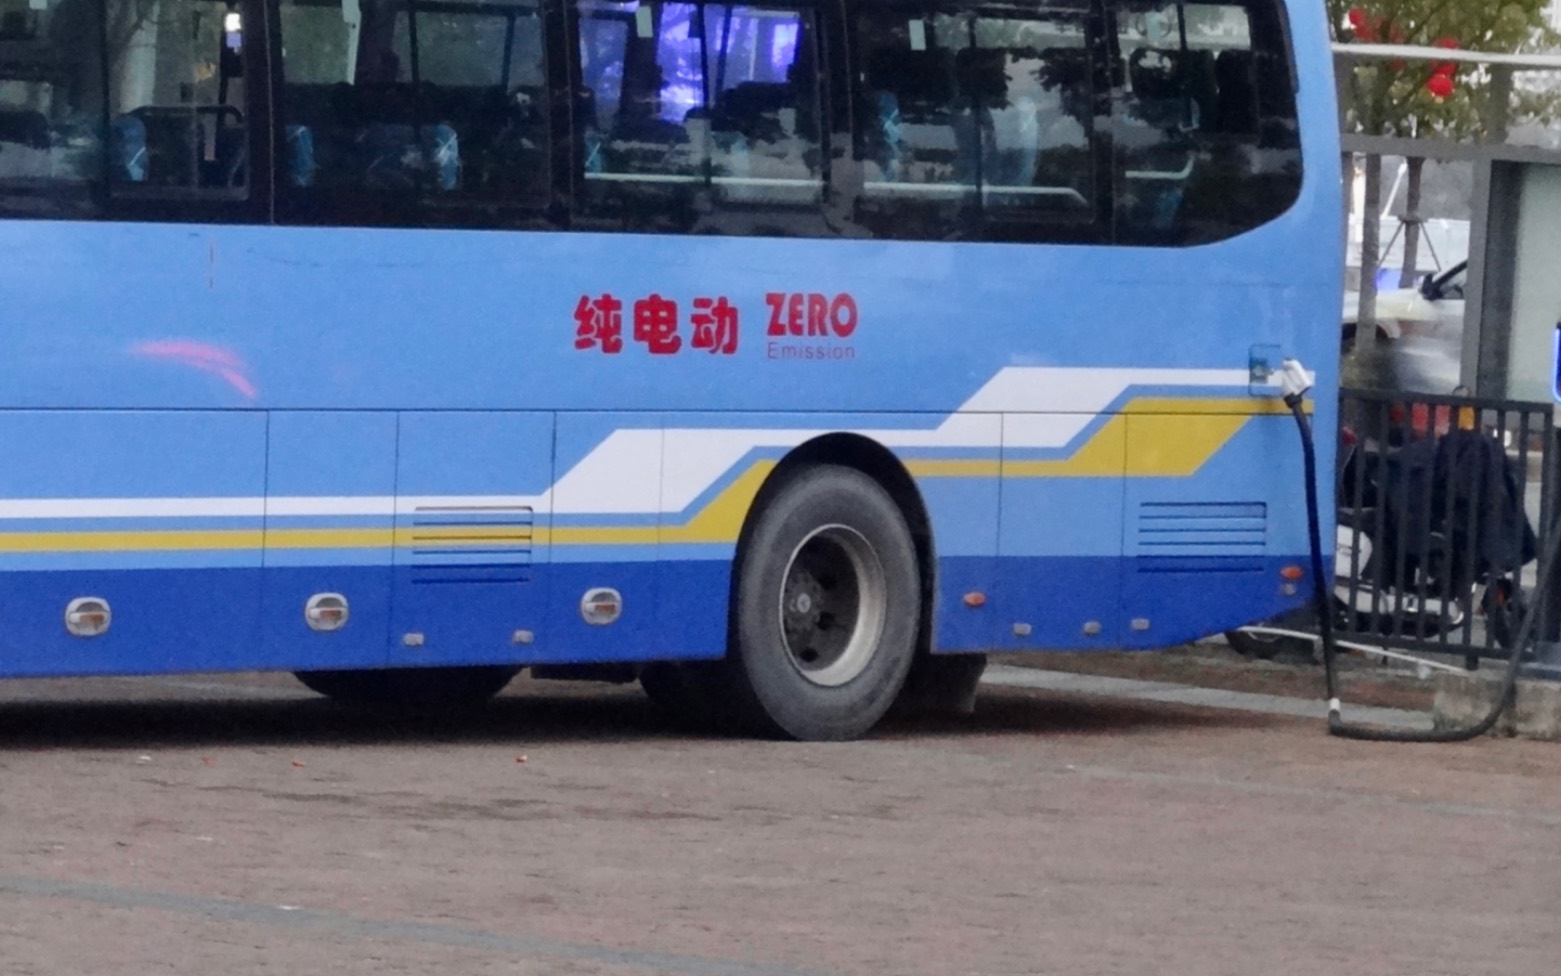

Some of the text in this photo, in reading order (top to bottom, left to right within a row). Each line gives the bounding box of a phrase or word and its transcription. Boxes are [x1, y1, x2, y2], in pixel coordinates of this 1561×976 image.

[574, 293, 739, 355] 纯电动
[765, 292, 858, 338] ZERO
[767, 341, 856, 361] Emission
